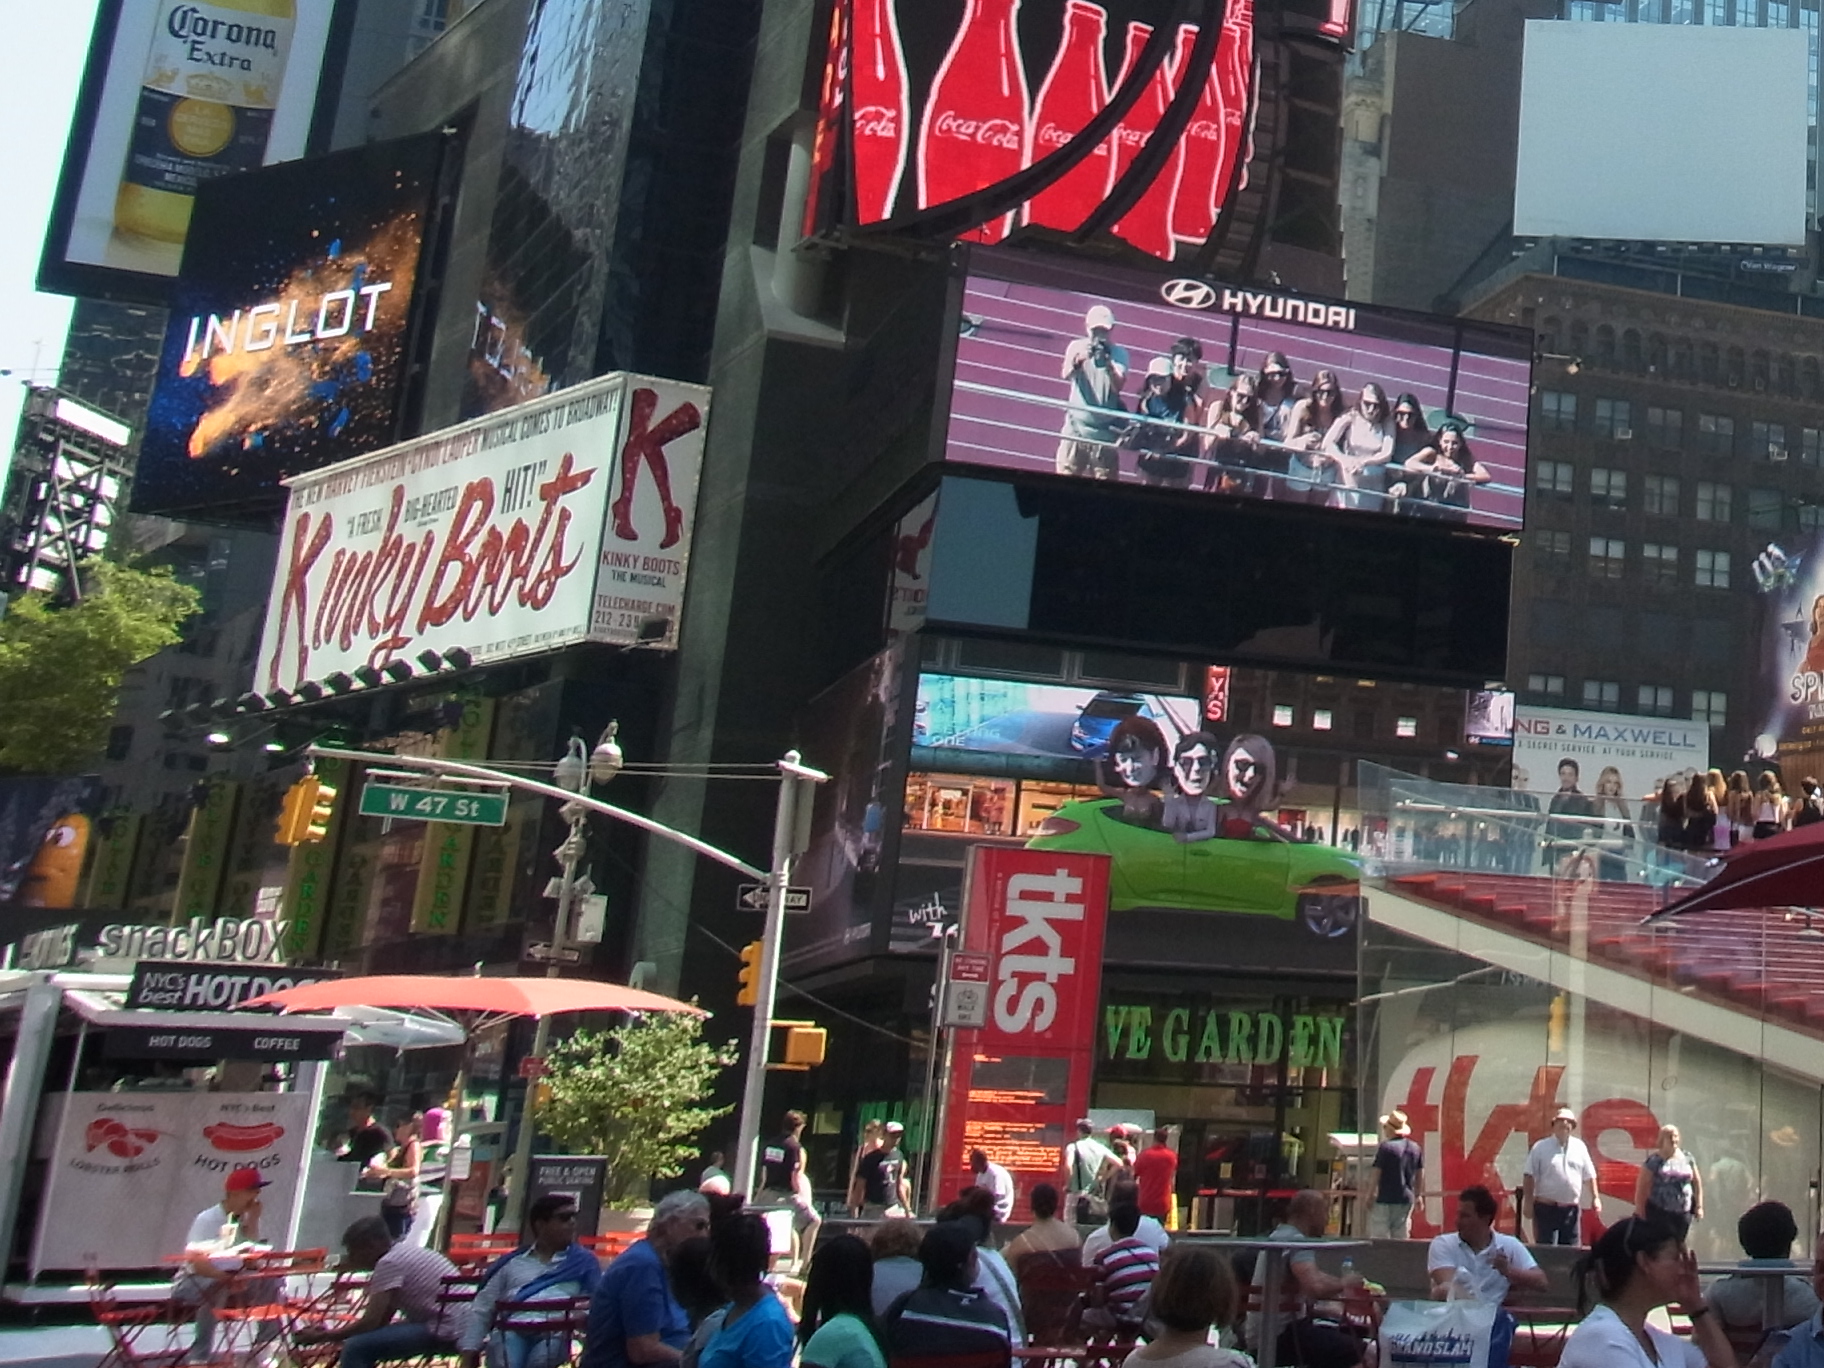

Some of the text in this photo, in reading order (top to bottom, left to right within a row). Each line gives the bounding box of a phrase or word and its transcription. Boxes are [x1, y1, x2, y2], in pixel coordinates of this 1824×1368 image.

[168, 4, 277, 51] Corona
[186, 38, 252, 72] Extra
[935, 110, 1020, 151] Coca-Cola
[183, 282, 393, 363] INGLOT
[1221, 289, 1357, 331] HYUNDAI
[268, 452, 598, 690] Kinky Boots
[601, 550, 680, 576] KINKY BOOTS
[611, 569, 666, 588] THE MUSICAL
[594, 610, 612, 626] 212
[1525, 740, 1558, 752] SECRET
[1602, 746, 1612, 756] AT
[1615, 747, 1637, 758] YOUR
[1555, 724, 1567, 736] &
[1572, 723, 1697, 749] MAXWELL
[389, 792, 480, 817] W 47 St
[909, 891, 947, 925] with
[99, 916, 291, 964] snackBOX
[993, 868, 1085, 1034] tkts
[139, 988, 181, 1005] best
[142, 972, 186, 990] NYC's
[184, 974, 246, 1006] HOT
[149, 1035, 301, 1050] HOT DOGS COFFEE
[1162, 1008, 1346, 1069] GARDEN
[194, 1154, 228, 1173] HOT
[1397, 1054, 1663, 1246] tkts
